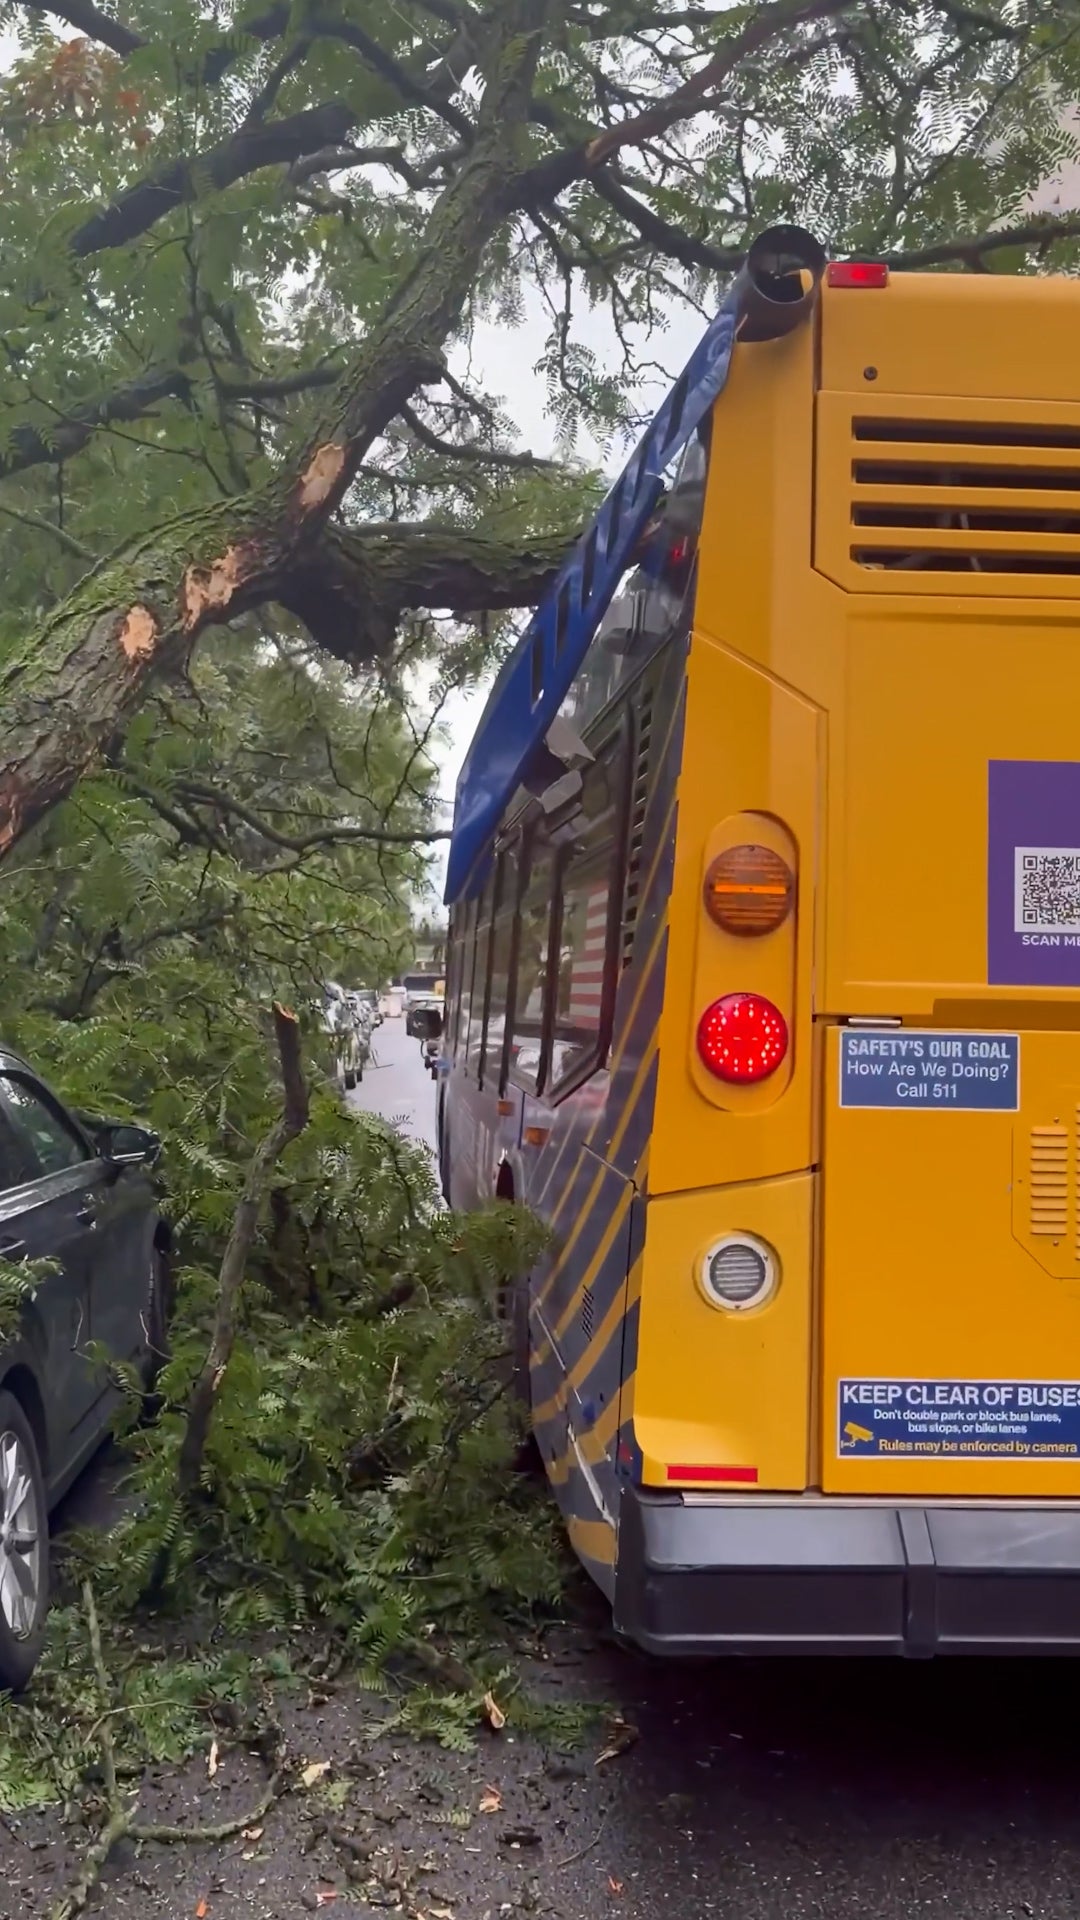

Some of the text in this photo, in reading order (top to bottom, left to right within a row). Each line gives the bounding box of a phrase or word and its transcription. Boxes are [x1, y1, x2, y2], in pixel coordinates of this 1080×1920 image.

[1022, 935, 1060, 946] SCAN
[848, 1039, 1011, 1059] SAFETY'S OUR GOAL
[847, 1061, 1009, 1081] How Are We Doing?
[896, 1082, 957, 1098] Call 511
[843, 1385, 1080, 1407] KEEP CLEAR OF BUSE
[874, 1409, 1061, 1423] Don't double park or block bus lanes,
[908, 1422, 1028, 1434] bus stops, or bike lanes
[879, 1439, 1078, 1454] Rules may be enforced by camera
